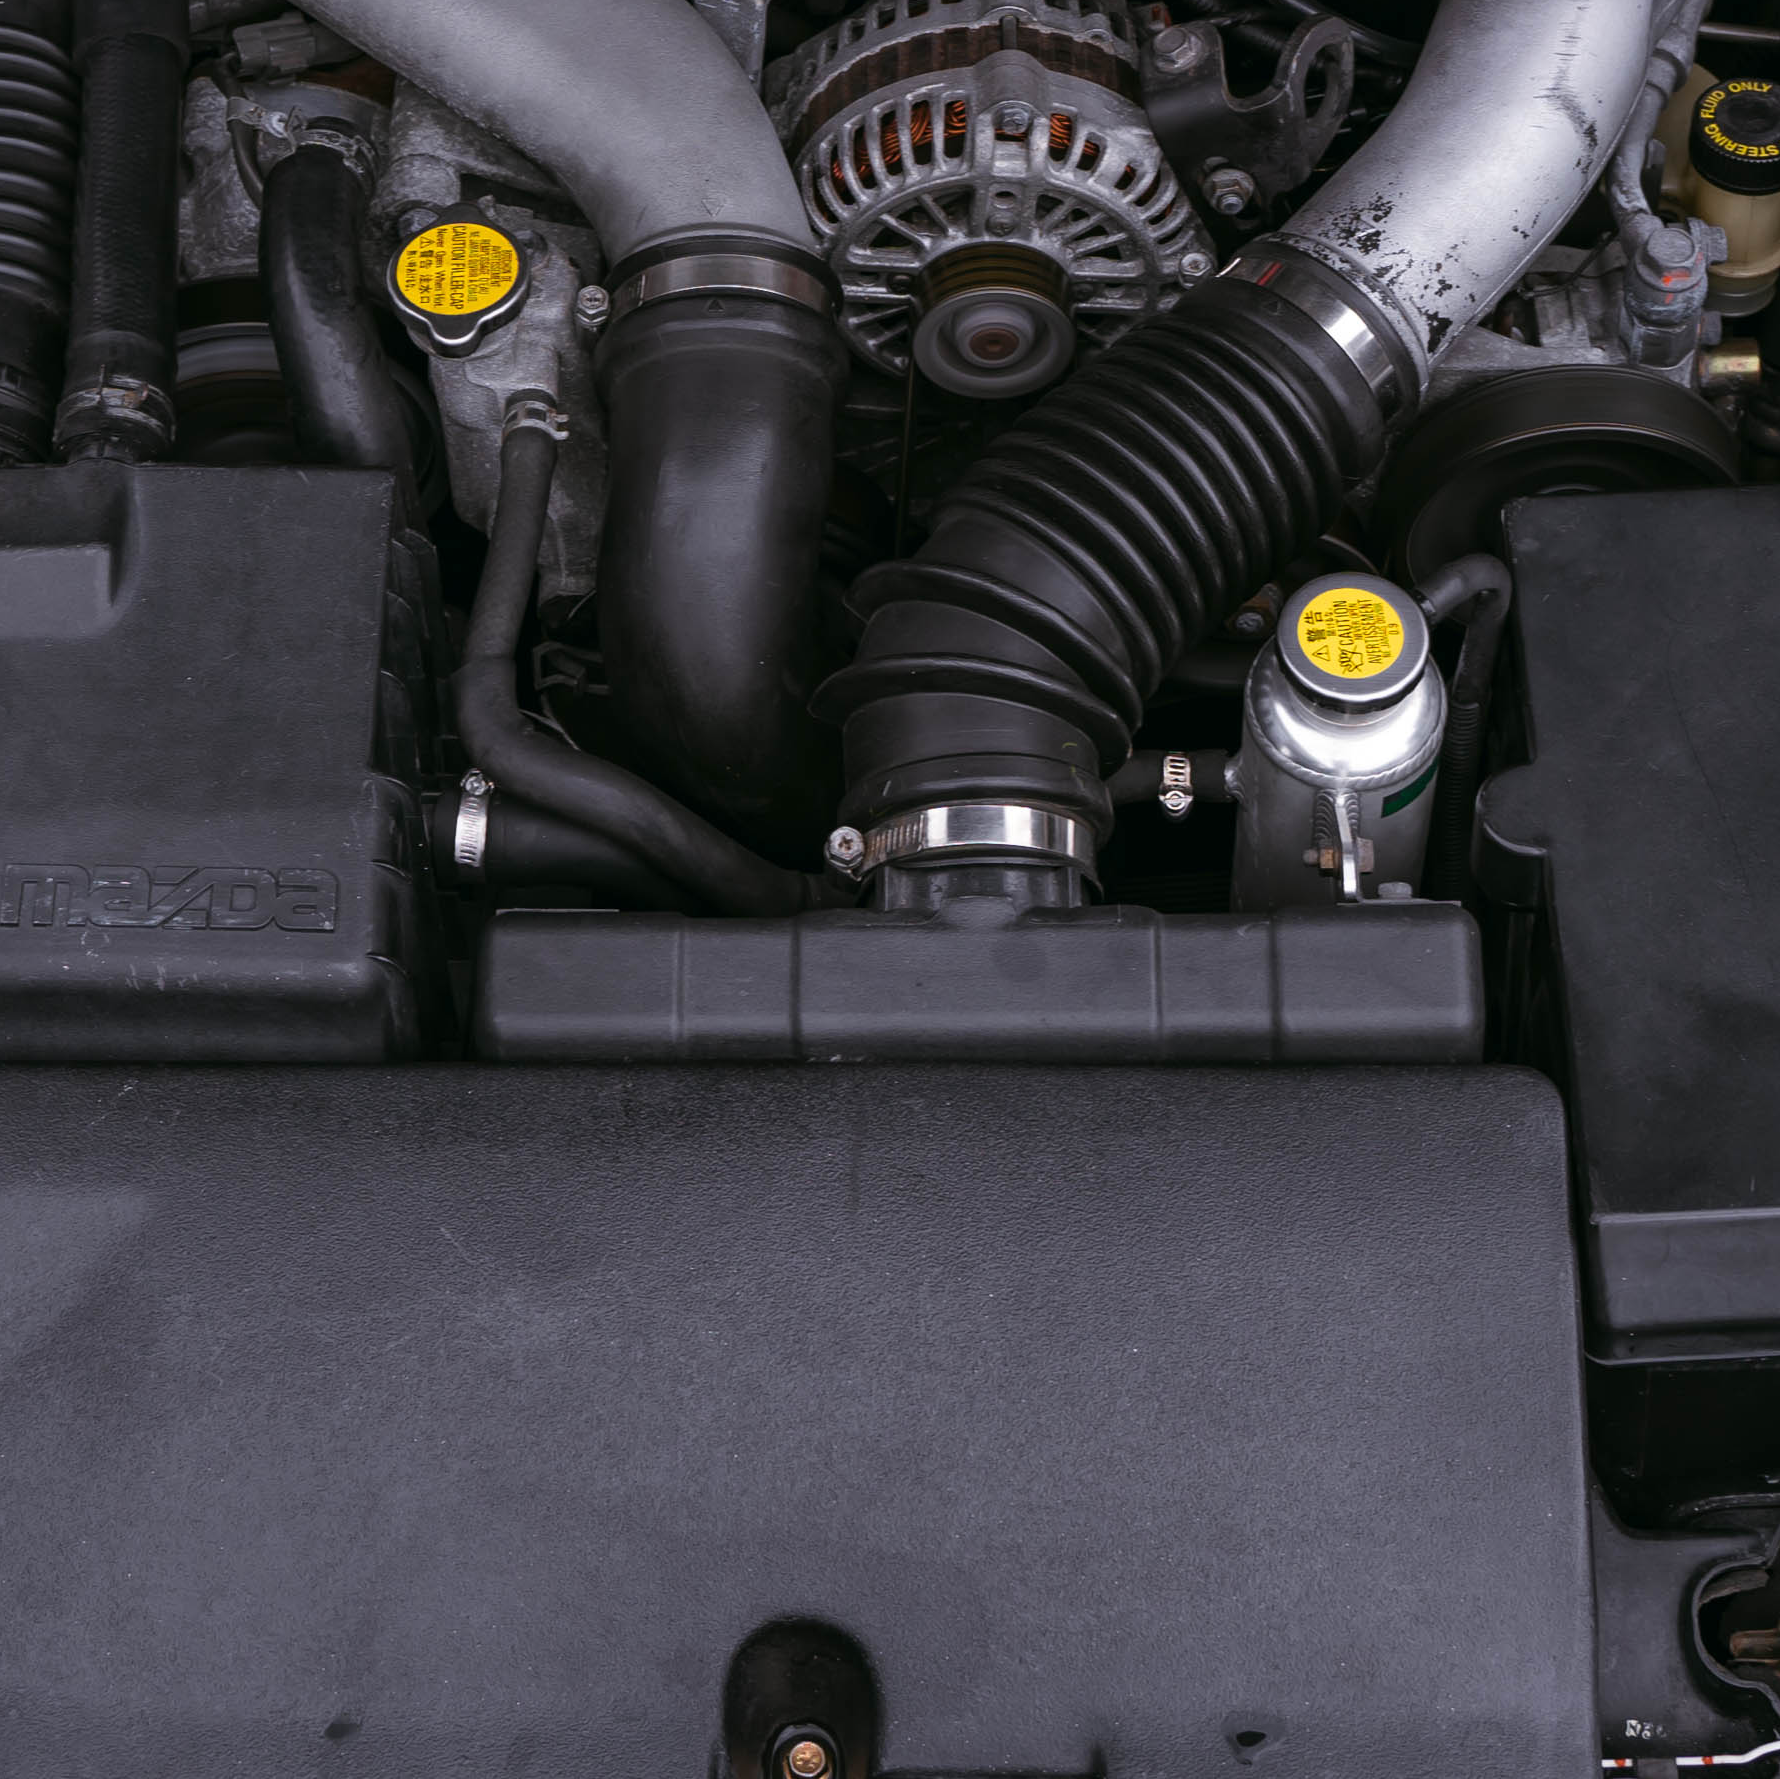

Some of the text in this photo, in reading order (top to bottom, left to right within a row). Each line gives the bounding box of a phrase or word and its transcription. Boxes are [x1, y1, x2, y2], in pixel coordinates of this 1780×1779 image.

[1728, 81, 1773, 93] ONLY
[1700, 90, 1726, 119] FLUID
[1704, 123, 1780, 157] STEERING
[437, 228, 447, 248] Never
[453, 226, 466, 261] CAUTION
[435, 250, 446, 268] Open
[436, 270, 446, 291] When
[1333, 600, 1353, 646] CAUTION
[1347, 602, 1359, 619] OPEN
[1357, 599, 1382, 664] AVERTISSEMENT
